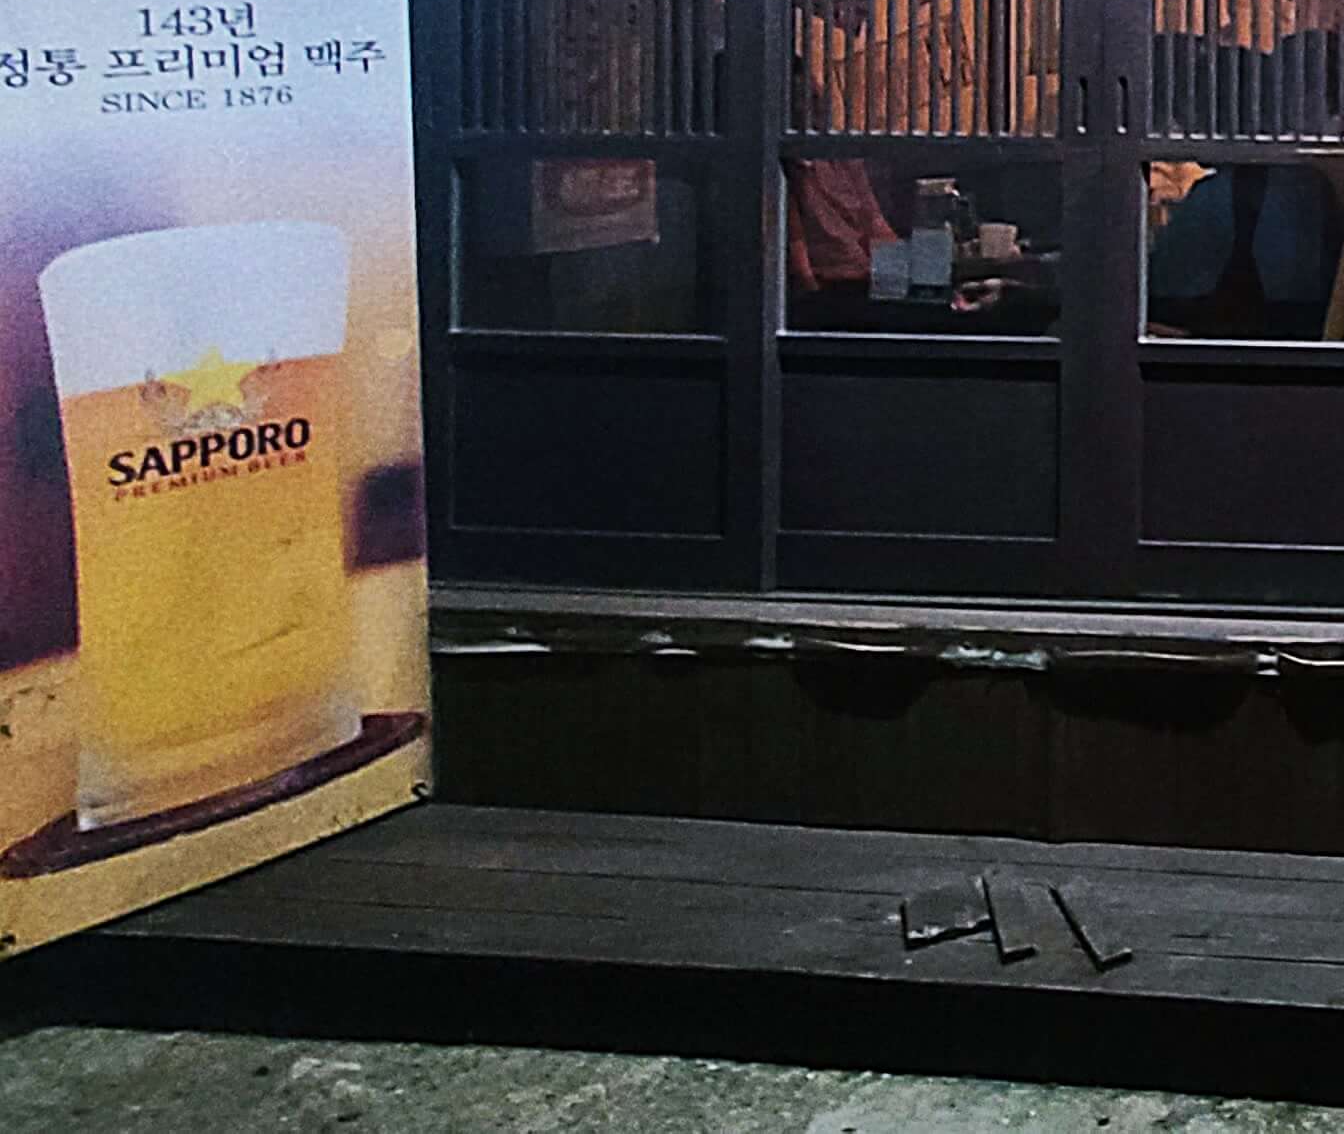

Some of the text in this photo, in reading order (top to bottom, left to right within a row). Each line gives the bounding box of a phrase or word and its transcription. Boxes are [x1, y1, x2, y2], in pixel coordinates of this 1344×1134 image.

[138, 1, 257, 39] 143년
[103, 42, 286, 81] 프리미엄
[304, 38, 386, 75] 맥주
[101, 85, 293, 115] SINCE 1876
[107, 417, 311, 487] SAPPORO
[113, 464, 238, 503] PREMIUM
